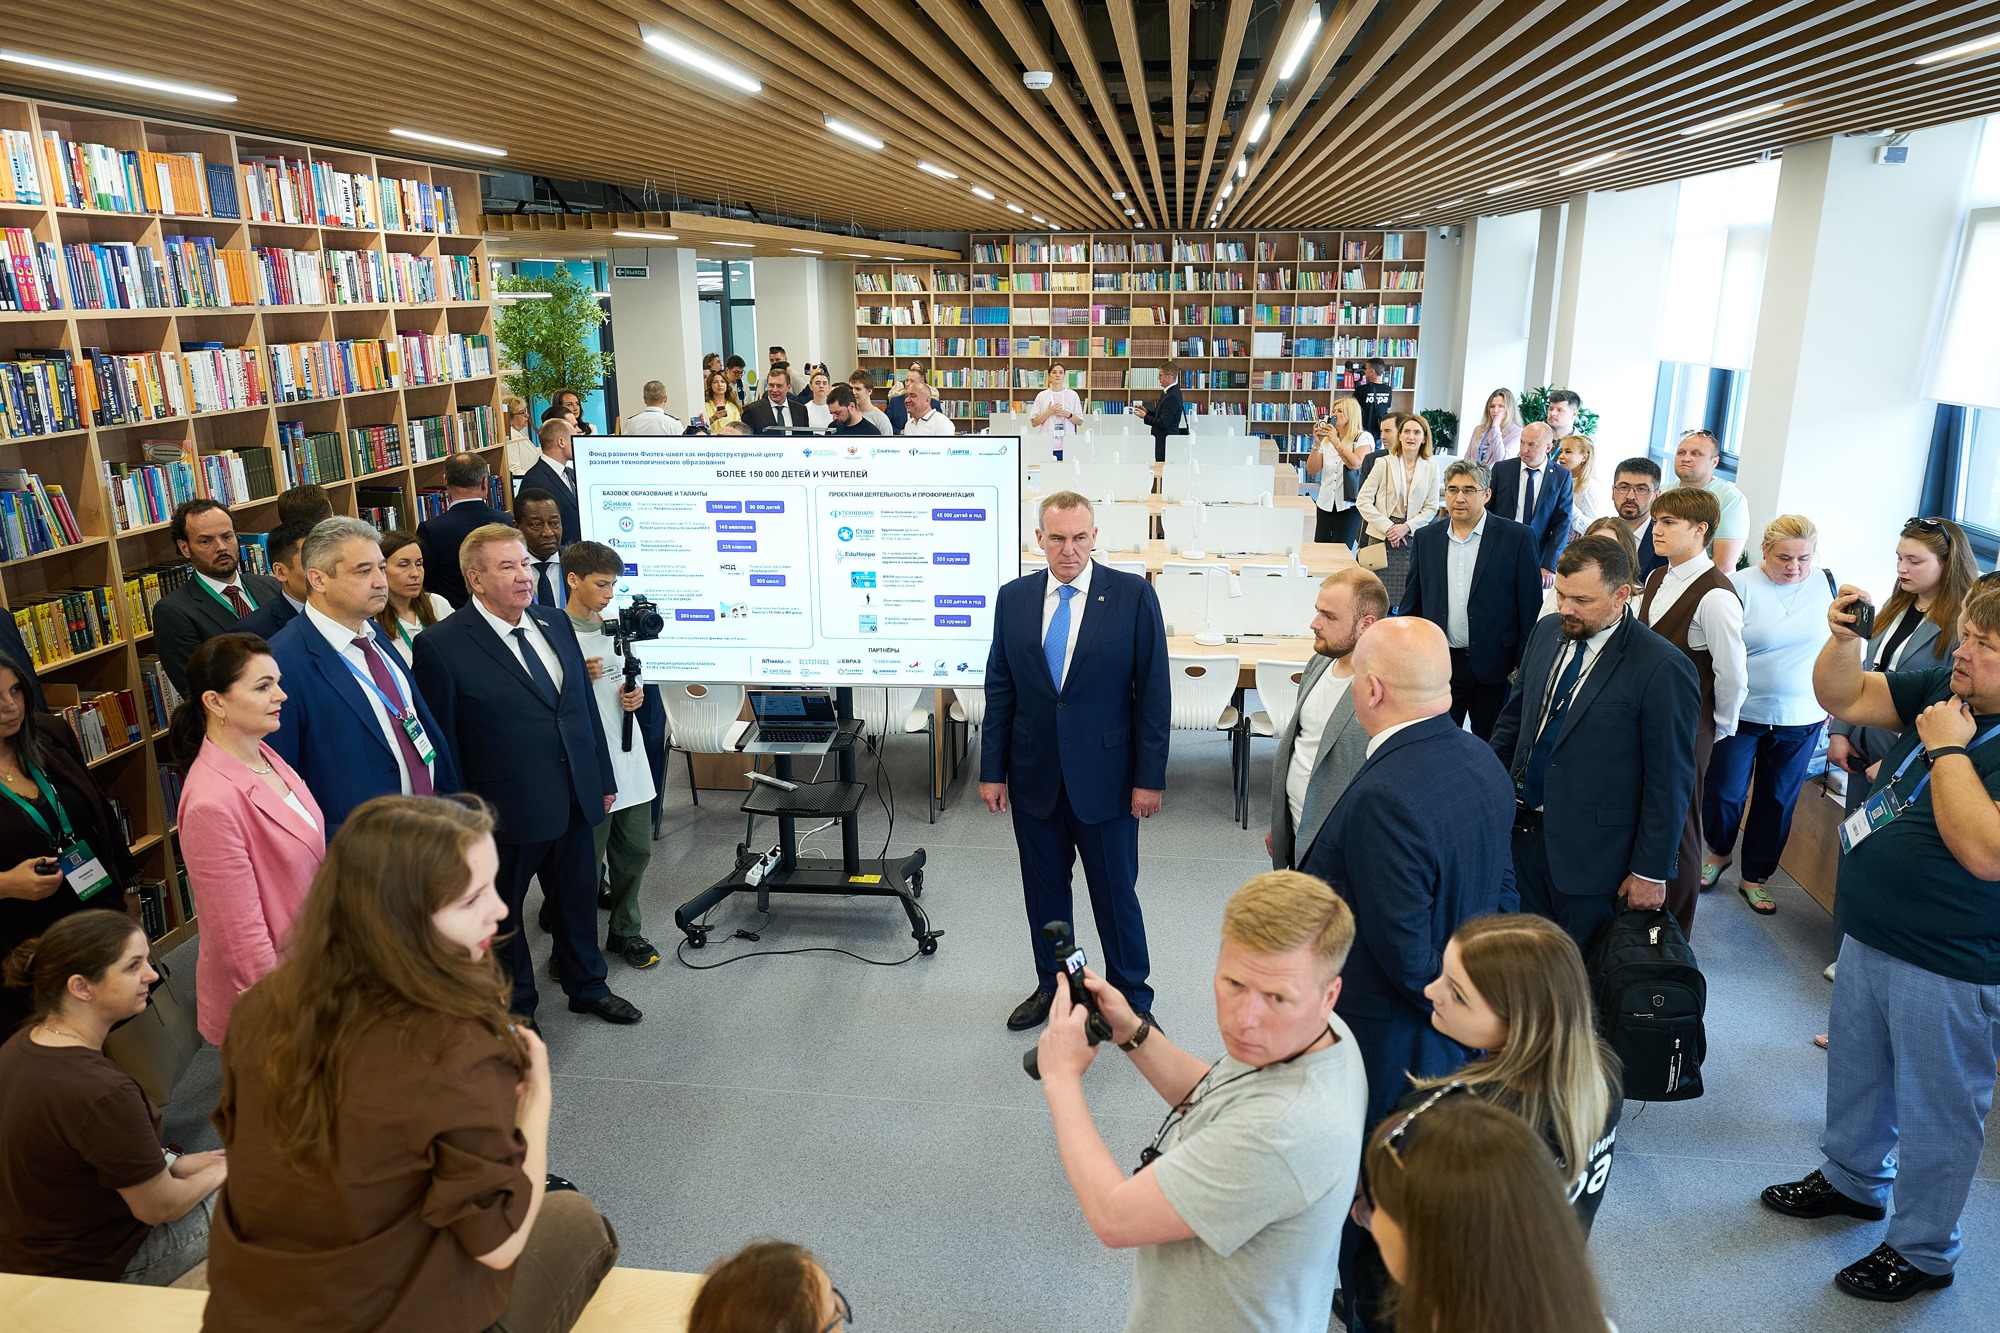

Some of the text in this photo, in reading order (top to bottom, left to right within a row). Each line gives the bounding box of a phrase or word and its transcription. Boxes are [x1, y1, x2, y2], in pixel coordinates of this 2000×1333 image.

[106, 379, 117, 415] LightWave
[15, 409, 23, 424] C#
[716, 469, 868, 479] БОЛЕЕ 150 000 ДЕТЕЙ И УЧИТЕЛЕЙ
[81, 882, 102, 897] UNESCO
